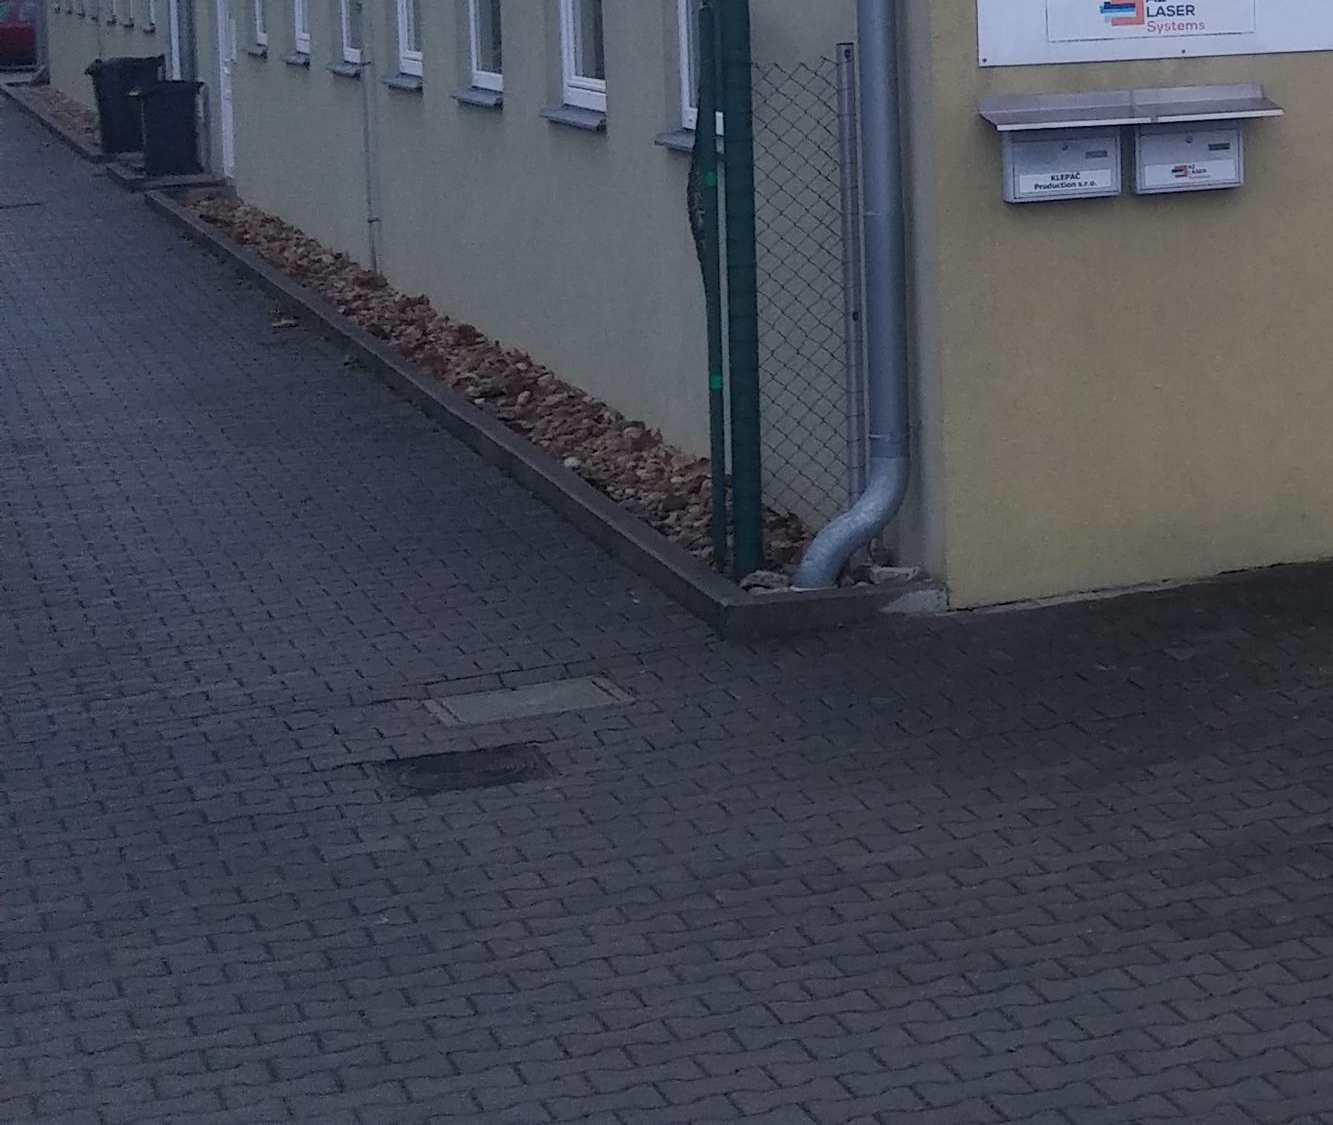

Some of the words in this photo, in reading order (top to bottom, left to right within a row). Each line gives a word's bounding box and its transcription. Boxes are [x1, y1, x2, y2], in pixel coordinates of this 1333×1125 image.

[1146, 4, 1196, 18] LASER
[1146, 19, 1206, 34] Systems
[1033, 180, 1077, 191] Production
